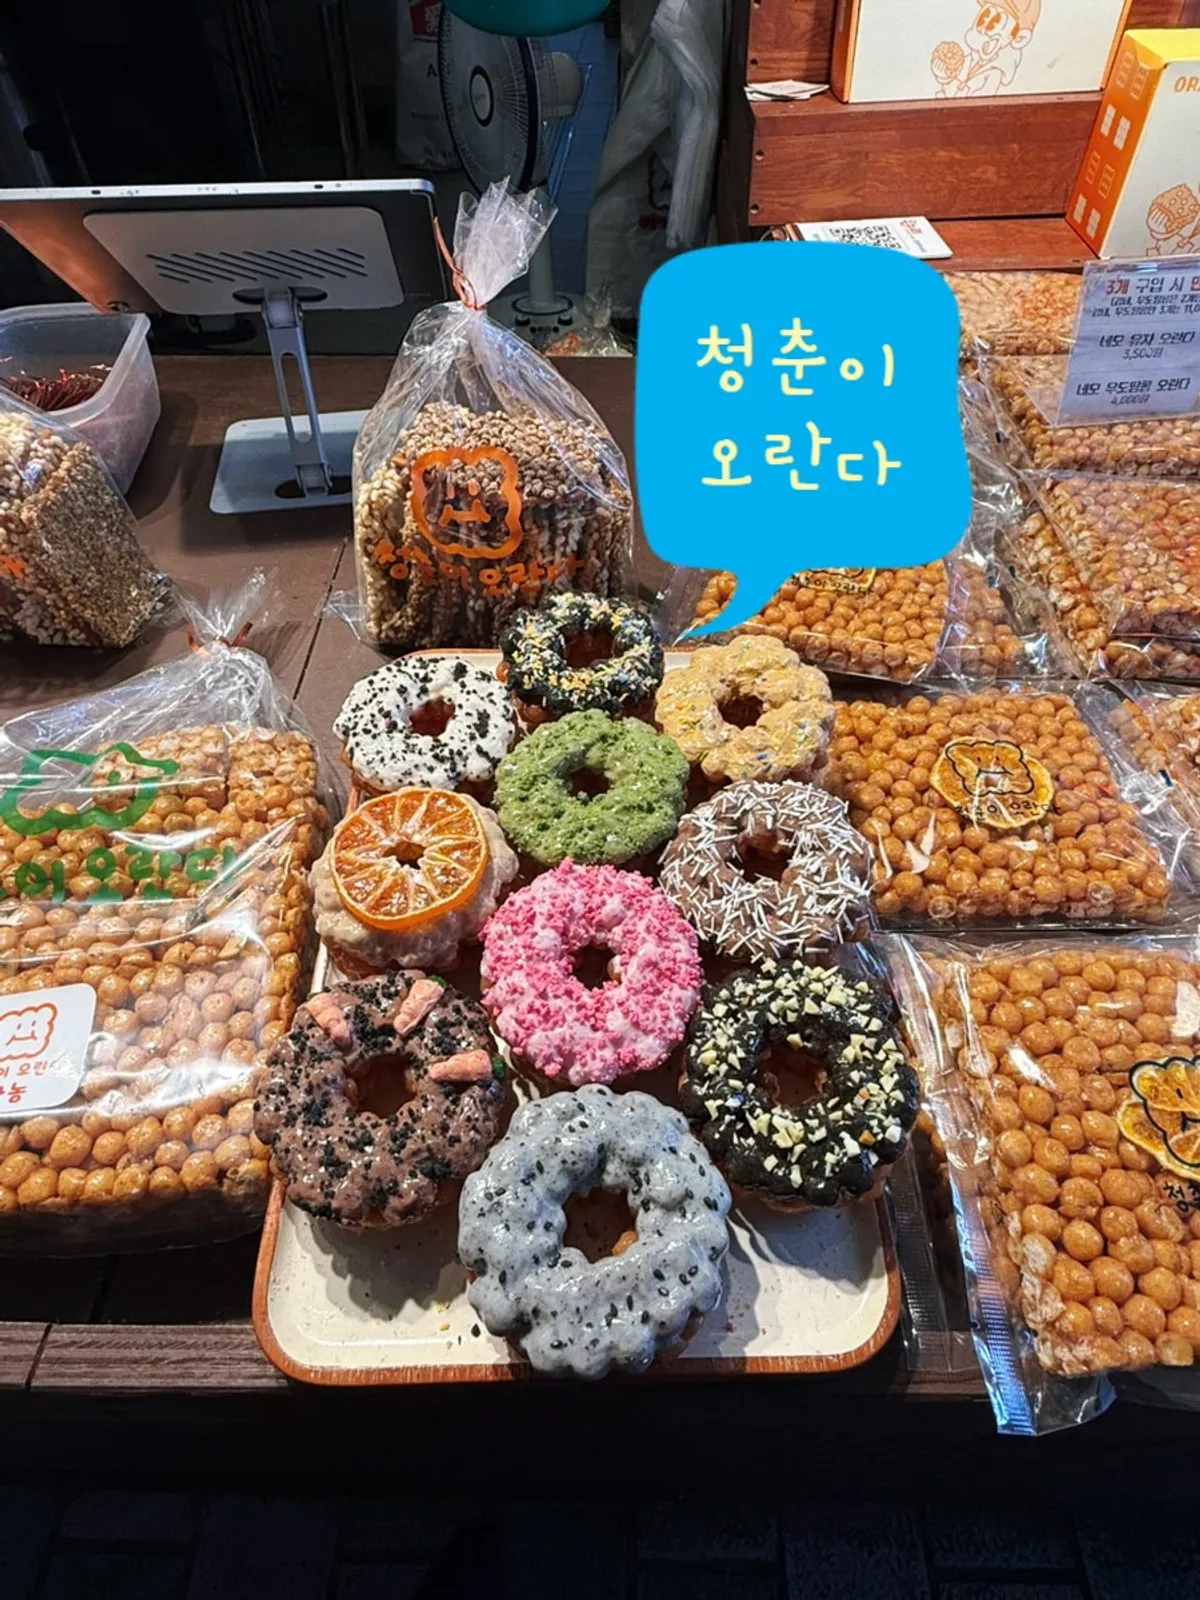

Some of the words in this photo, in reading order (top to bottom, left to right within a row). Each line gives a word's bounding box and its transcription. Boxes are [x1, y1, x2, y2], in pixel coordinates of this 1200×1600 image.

[1174, 75, 1200, 93] OR
[1105, 278, 1130, 295] 3개
[1136, 277, 1164, 293] 구입
[1168, 276, 1185, 292] 시
[1099, 334, 1125, 348] 네모
[1129, 333, 1155, 347] 유자
[1158, 331, 1196, 345] 오란다
[1076, 382, 1101, 396] 네모
[1105, 380, 1153, 395] 우도땅콩
[1156, 377, 1191, 392] 오란다
[84, 843, 237, 904] 오란다
